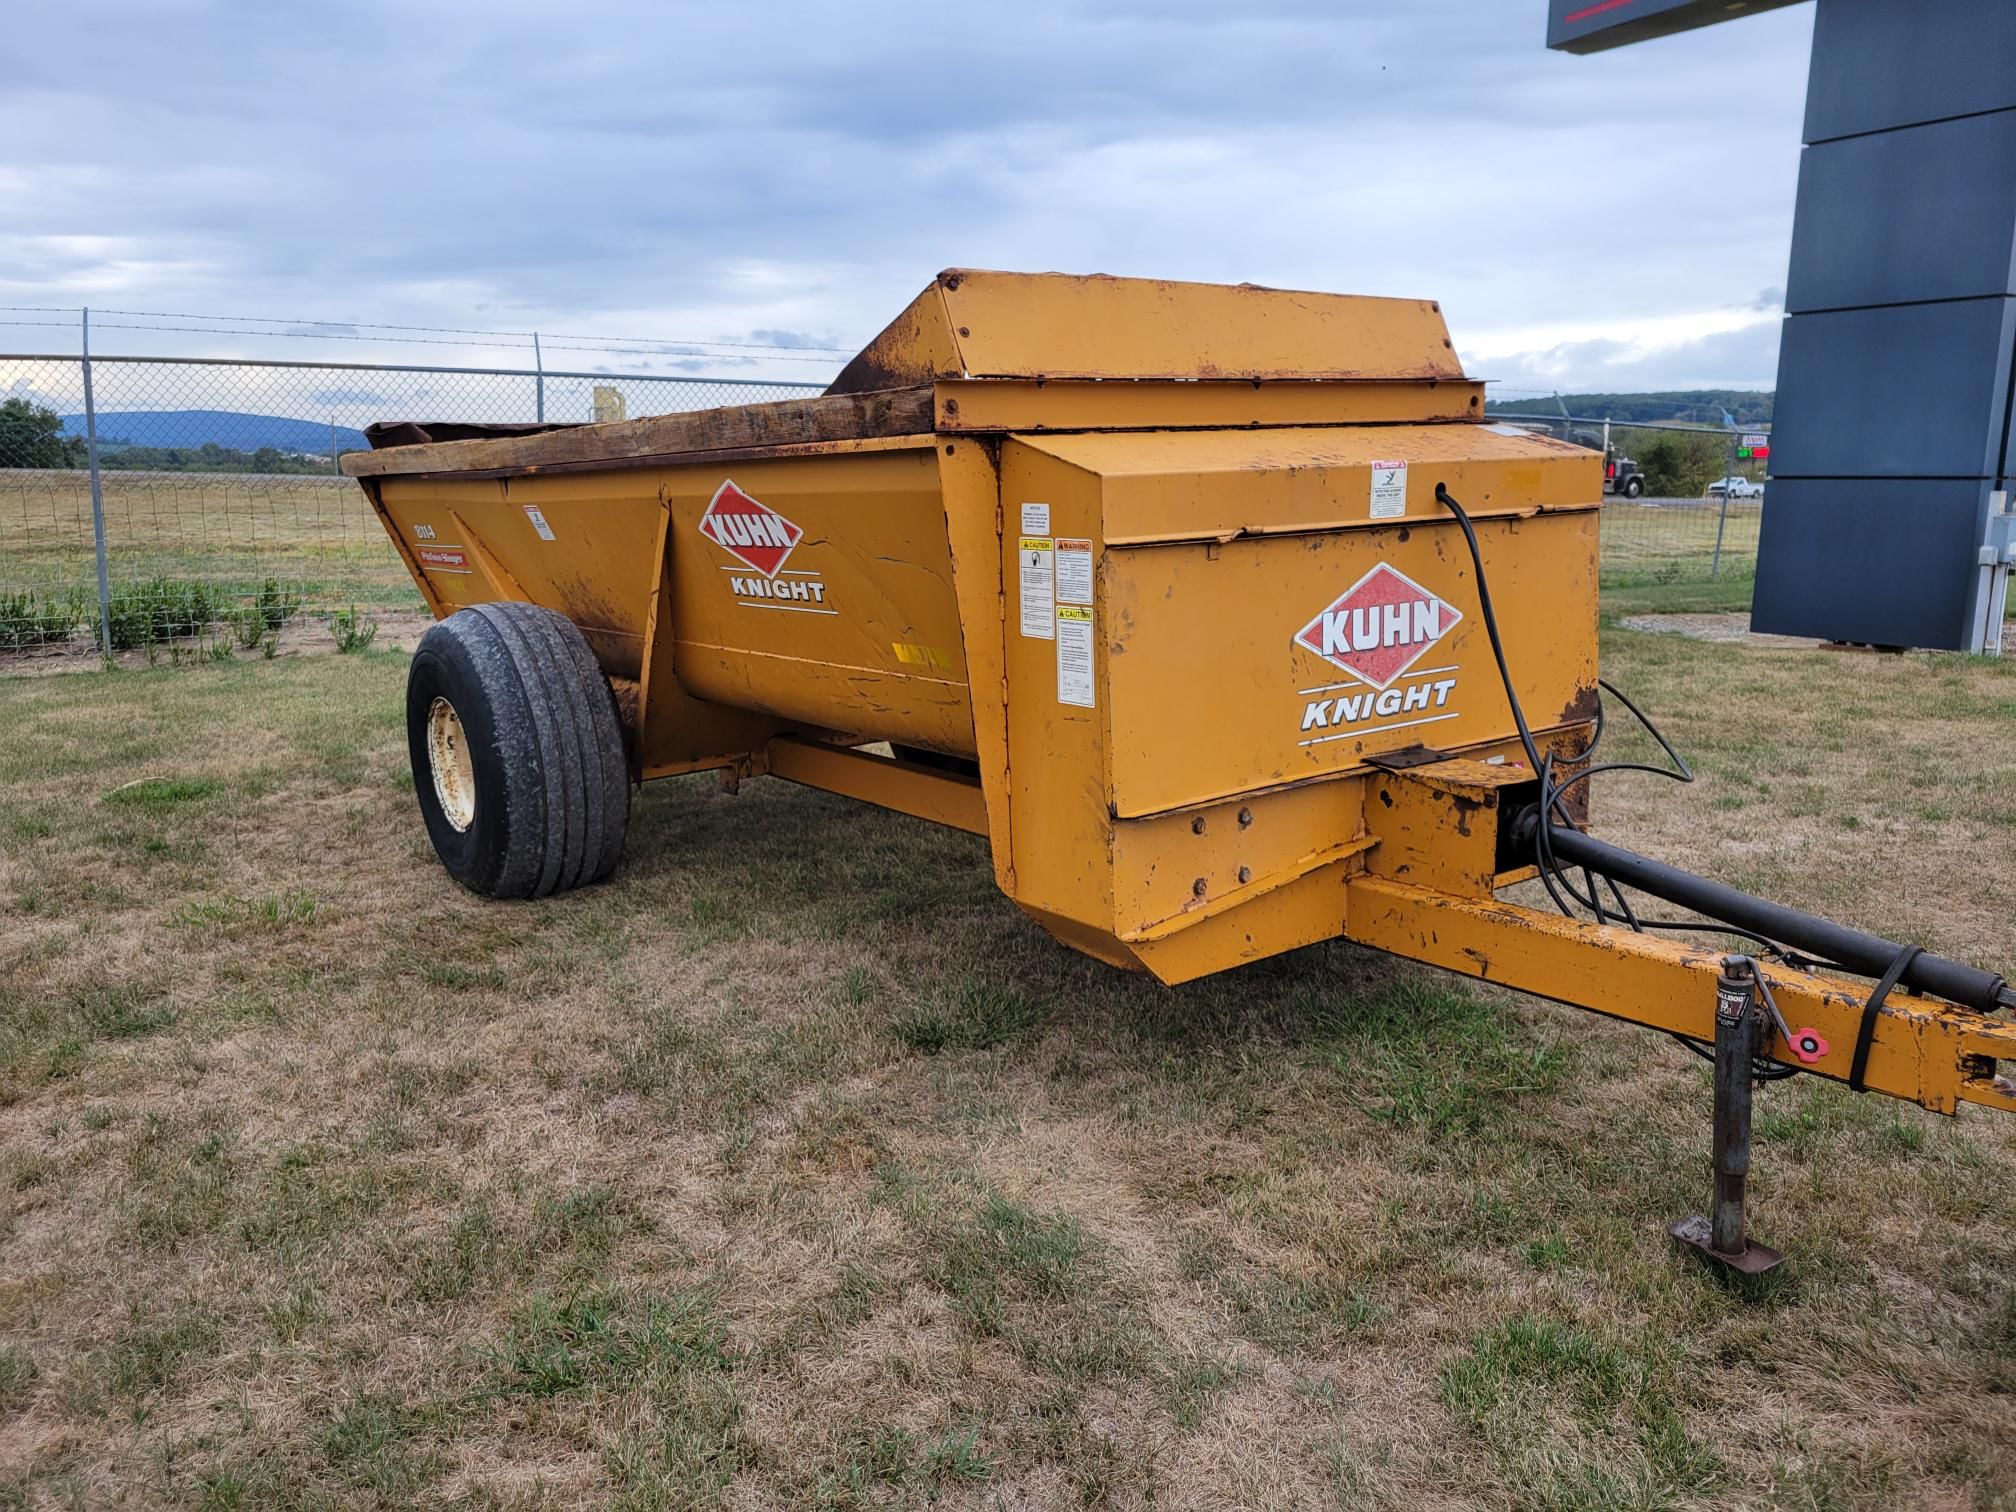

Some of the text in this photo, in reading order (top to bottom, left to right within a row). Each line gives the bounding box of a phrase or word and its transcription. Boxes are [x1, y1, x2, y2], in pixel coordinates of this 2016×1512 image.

[414, 525, 436, 540] 8114
[706, 513, 793, 548] KUHN
[1064, 543, 1090, 551] WARNING
[731, 577, 825, 603] KNIGHT
[1065, 610, 1091, 619] CAUTION
[1322, 599, 1440, 656] KUHN
[1301, 679, 1456, 731] KNIGHT
